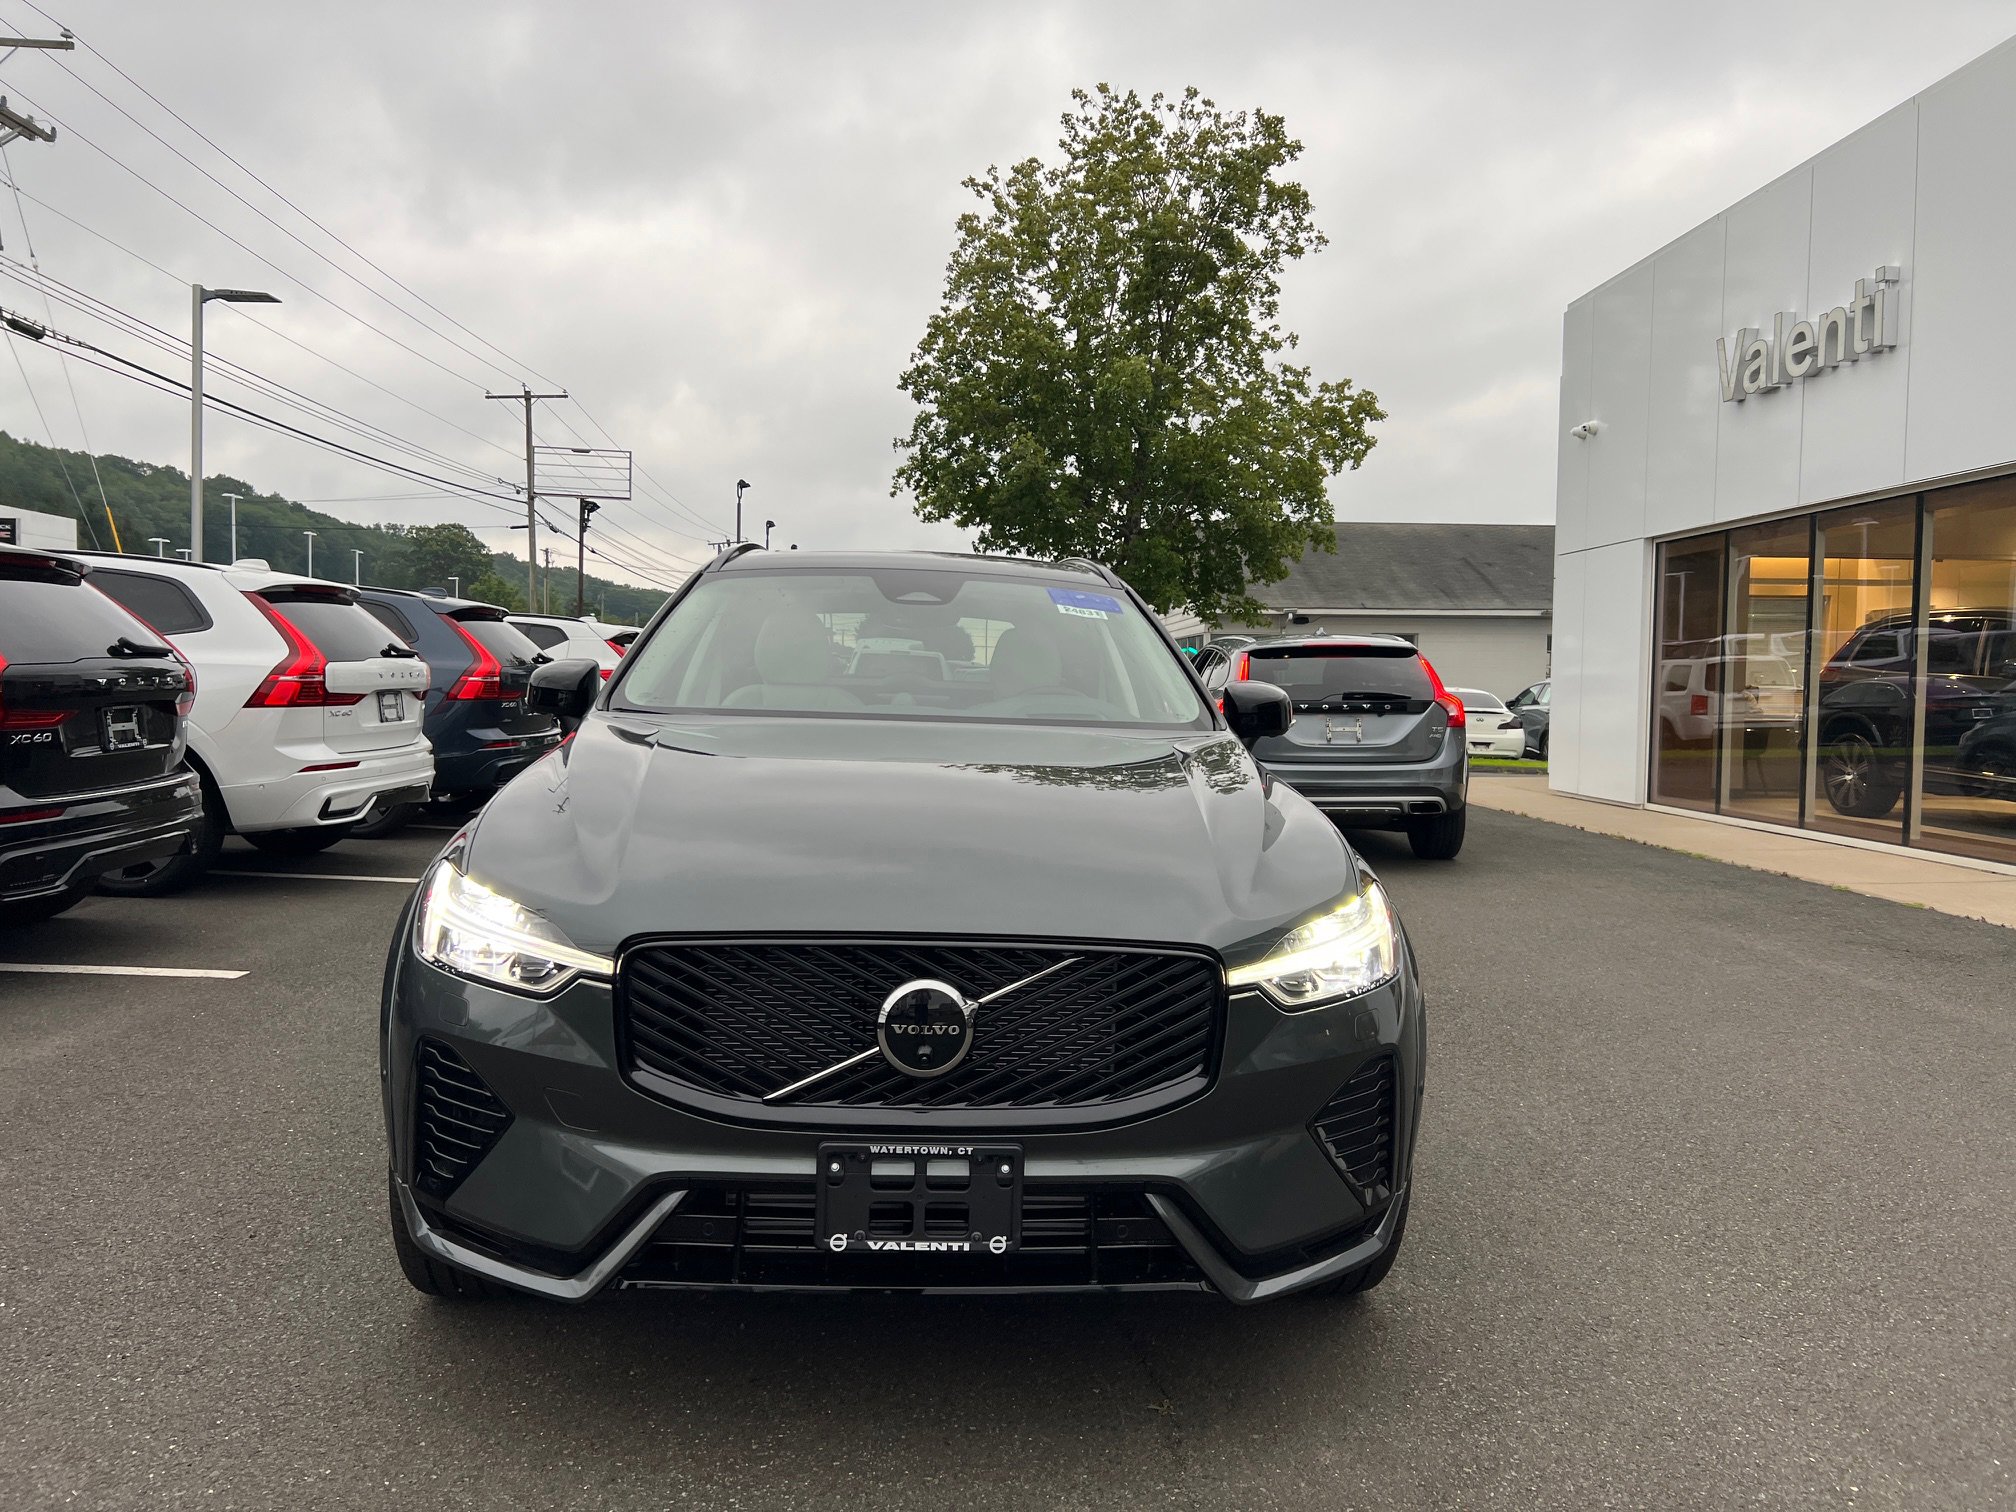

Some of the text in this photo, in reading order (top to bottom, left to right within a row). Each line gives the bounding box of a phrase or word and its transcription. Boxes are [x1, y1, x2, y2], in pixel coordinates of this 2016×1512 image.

[1716, 265, 1899, 402] Valenti
[328, 709, 353, 718] XC60
[10, 733, 52, 745] XC60
[891, 1024, 960, 1035] VOLVO
[870, 1146, 974, 1155] WATERTOWN, CT
[866, 1241, 970, 1251] VALENTI
